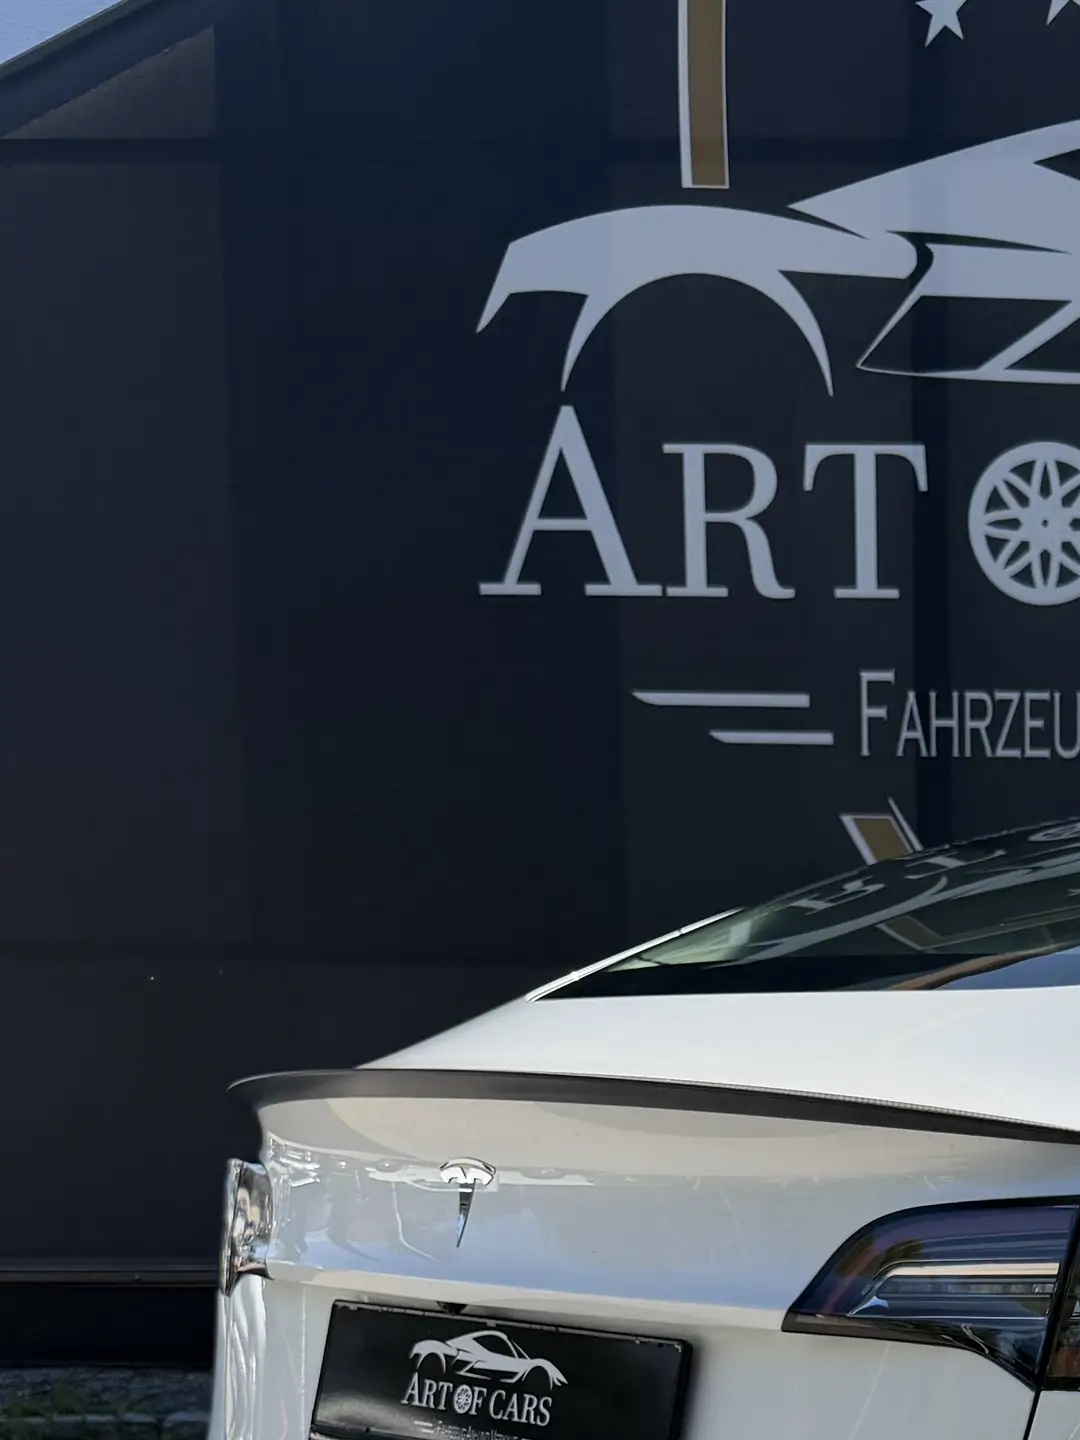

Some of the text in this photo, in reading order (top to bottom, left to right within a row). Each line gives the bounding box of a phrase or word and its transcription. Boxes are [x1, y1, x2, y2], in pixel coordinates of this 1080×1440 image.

[480, 406, 927, 598] ART
[401, 1372, 552, 1426] ART OF CARS
